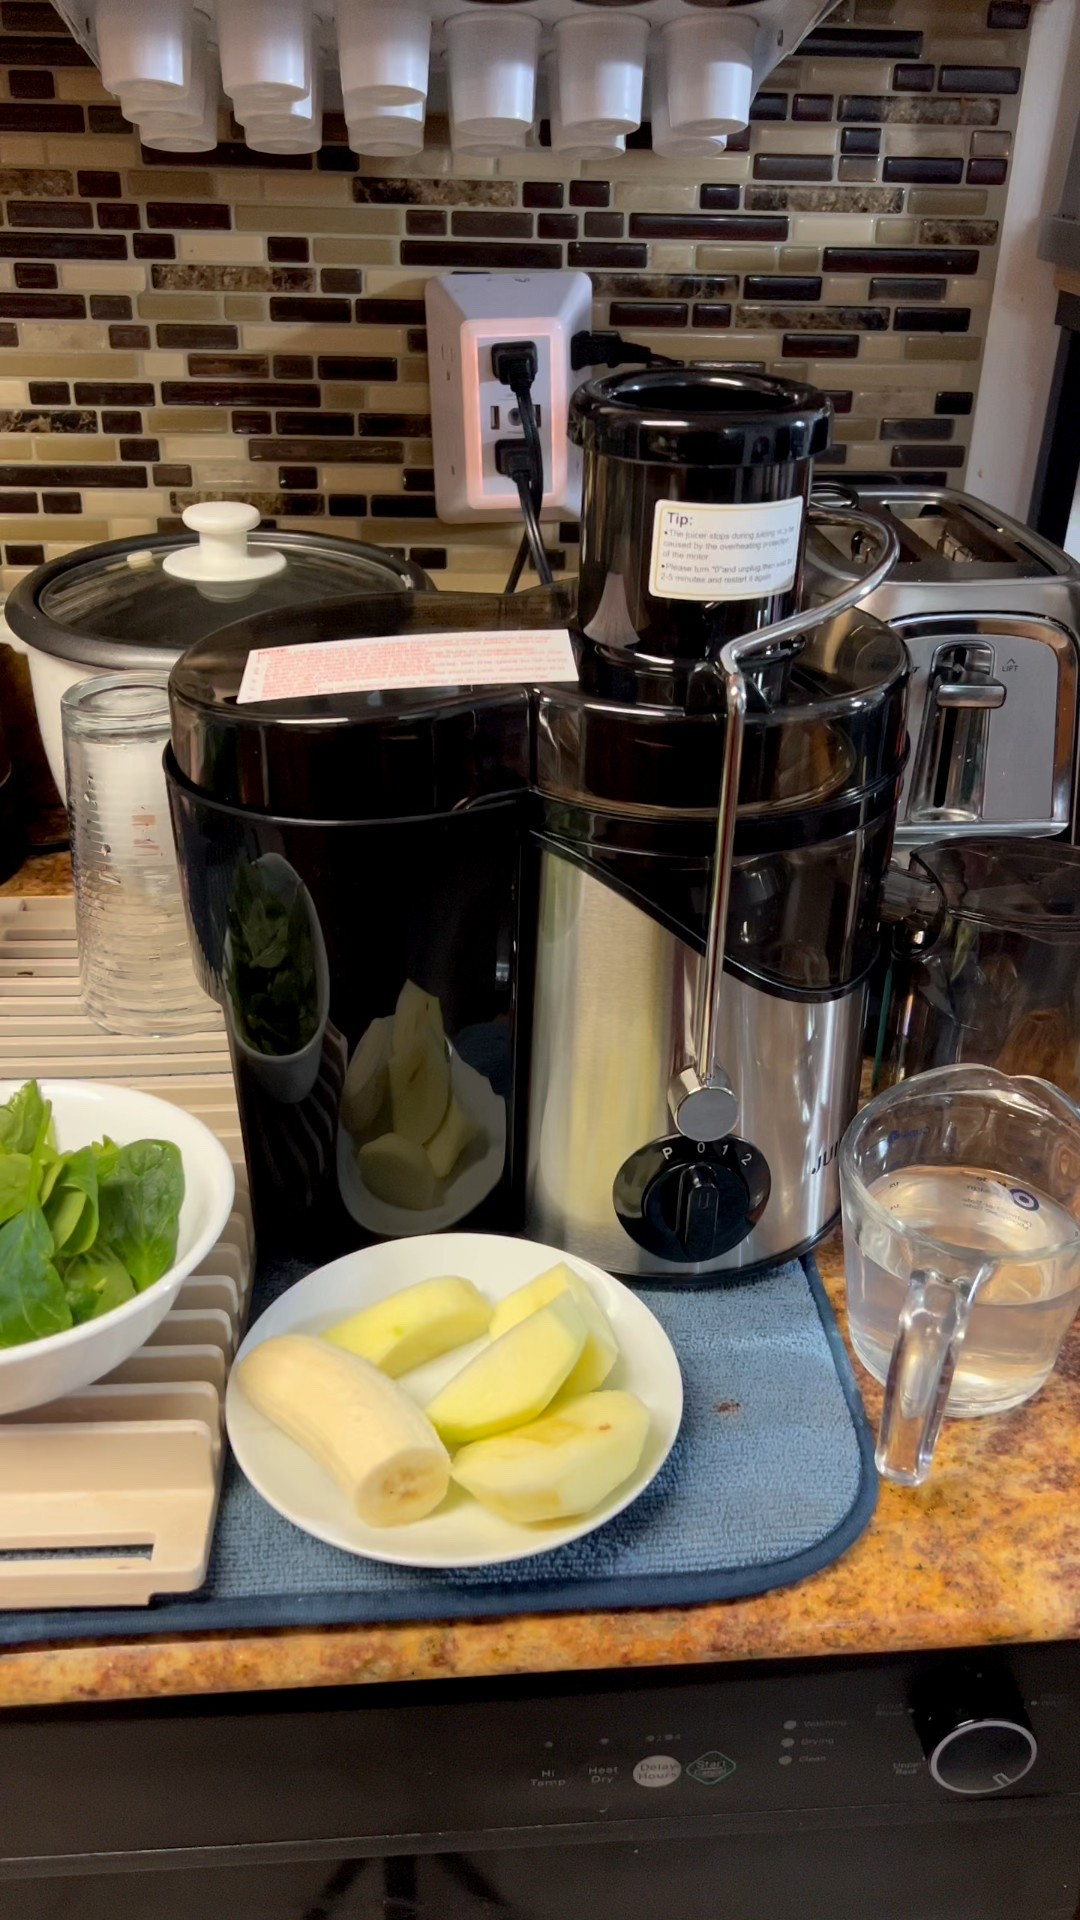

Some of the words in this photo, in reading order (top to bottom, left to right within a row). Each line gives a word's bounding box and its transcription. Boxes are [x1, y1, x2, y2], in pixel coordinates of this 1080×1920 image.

[667, 511, 693, 527] Tip:
[685, 531, 707, 539] juicer
[709, 532, 730, 540] stops
[731, 532, 754, 540] during
[663, 540, 691, 549] caused
[693, 541, 703, 550] by
[705, 542, 718, 550] the
[719, 541, 761, 551] overheating
[665, 562, 692, 572] Please
[694, 565, 710, 573] turn
[660, 572, 673, 581] 2-5
[674, 574, 706, 583] minutes
[707, 576, 722, 584] and
[723, 576, 747, 584] restart
[1001, 664, 1020, 672] LIFT
[662, 1146, 673, 1160] P
[722, 1144, 728, 1156] 1
[740, 1153, 753, 1166] 2
[640, 1763, 678, 1772] Delay
[696, 1760, 726, 1768] Start
[541, 1769, 555, 1778] Hi
[588, 1766, 619, 1775] Heat
[591, 1774, 614, 1784] Dry
[637, 1771, 678, 1782] Hours
[530, 1778, 566, 1787] Temp
